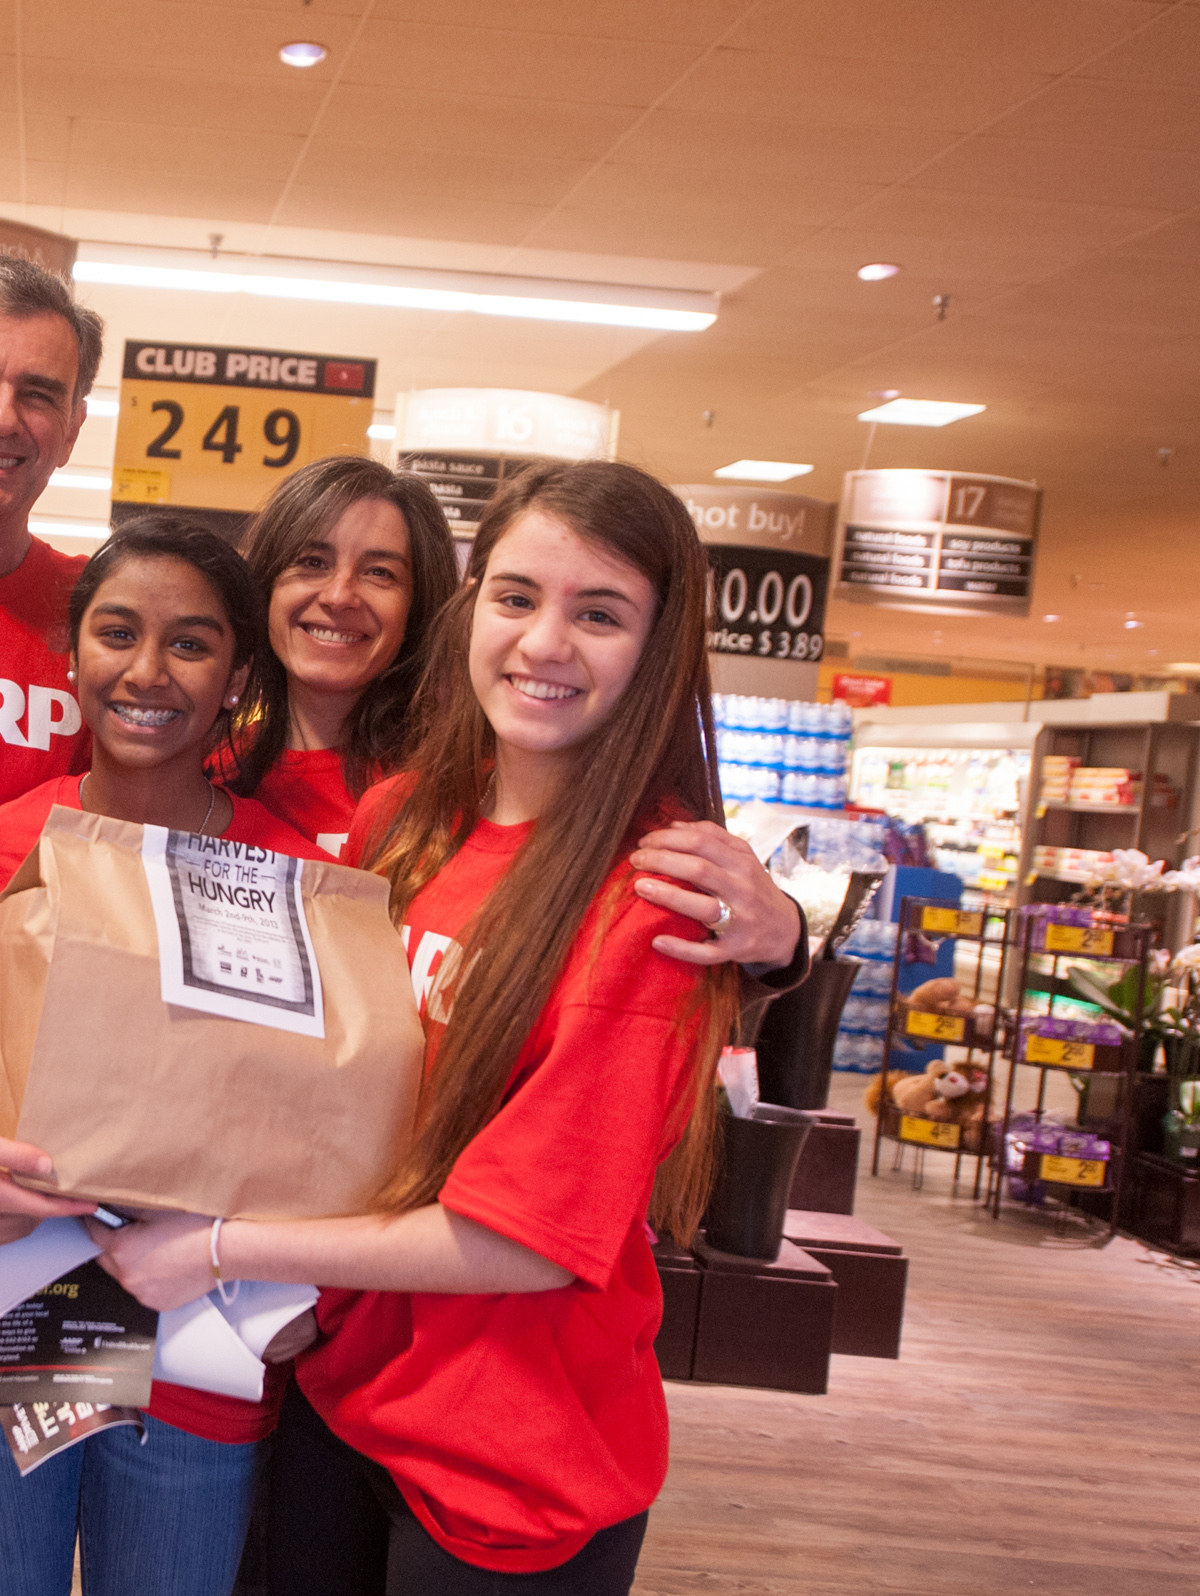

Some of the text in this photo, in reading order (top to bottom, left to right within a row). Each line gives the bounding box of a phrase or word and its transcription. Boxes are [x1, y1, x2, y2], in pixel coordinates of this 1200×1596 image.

[136, 347, 318, 386] CLUB PRICE
[495, 403, 534, 441] 16
[954, 486, 986, 518] 17
[686, 499, 807, 541] hot buy!
[759, 630, 772, 656] $
[187, 832, 277, 865] HARVEST
[204, 859, 259, 885] FOR THE
[188, 872, 276, 914] HUNGRY
